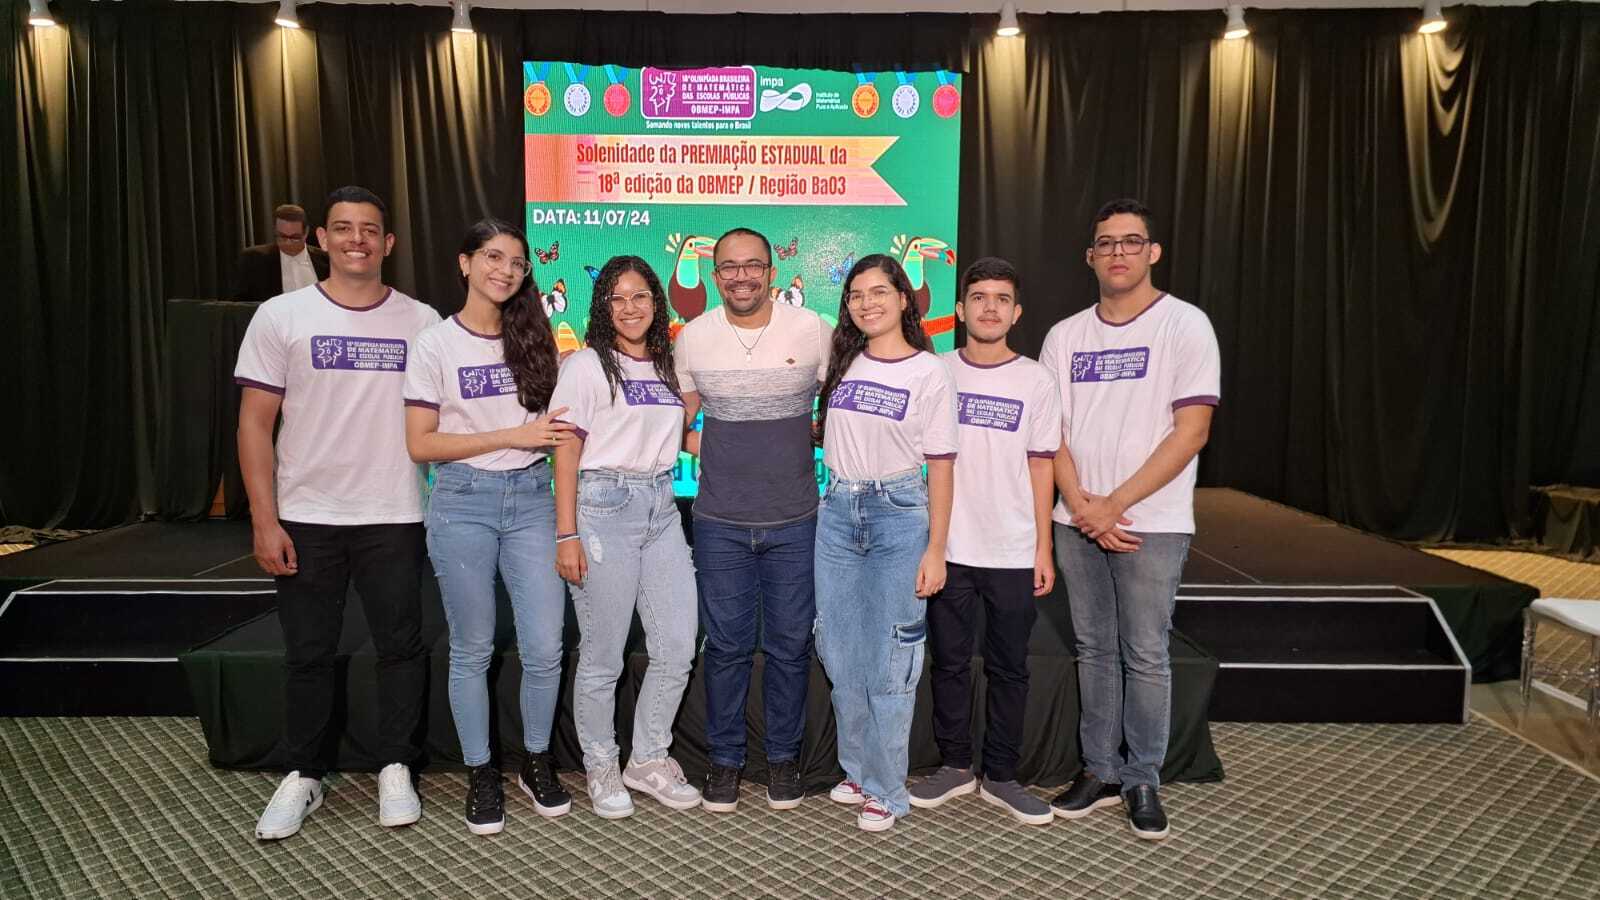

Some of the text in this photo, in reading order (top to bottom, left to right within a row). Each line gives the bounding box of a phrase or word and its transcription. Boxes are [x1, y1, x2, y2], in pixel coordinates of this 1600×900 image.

[697, 83, 750, 91] MATEMÁTICA
[760, 76, 784, 88] impa
[682, 91, 750, 100] DAS ESCOLAS PÚBLICAS
[691, 105, 741, 114] OBMEP-IMPA
[646, 121, 673, 129] Somando
[691, 121, 715, 129] talentos
[716, 122, 729, 131] para
[735, 121, 752, 129] Brasil
[577, 140, 847, 171] Solenidade da PREMIAÇÃO ESTADUAL da
[598, 172, 846, 200] 18ª edição da OBMEP / Região Ba03
[533, 209, 650, 230] DATA: 11/07/24
[354, 361, 398, 369] OBMEP-IMPA
